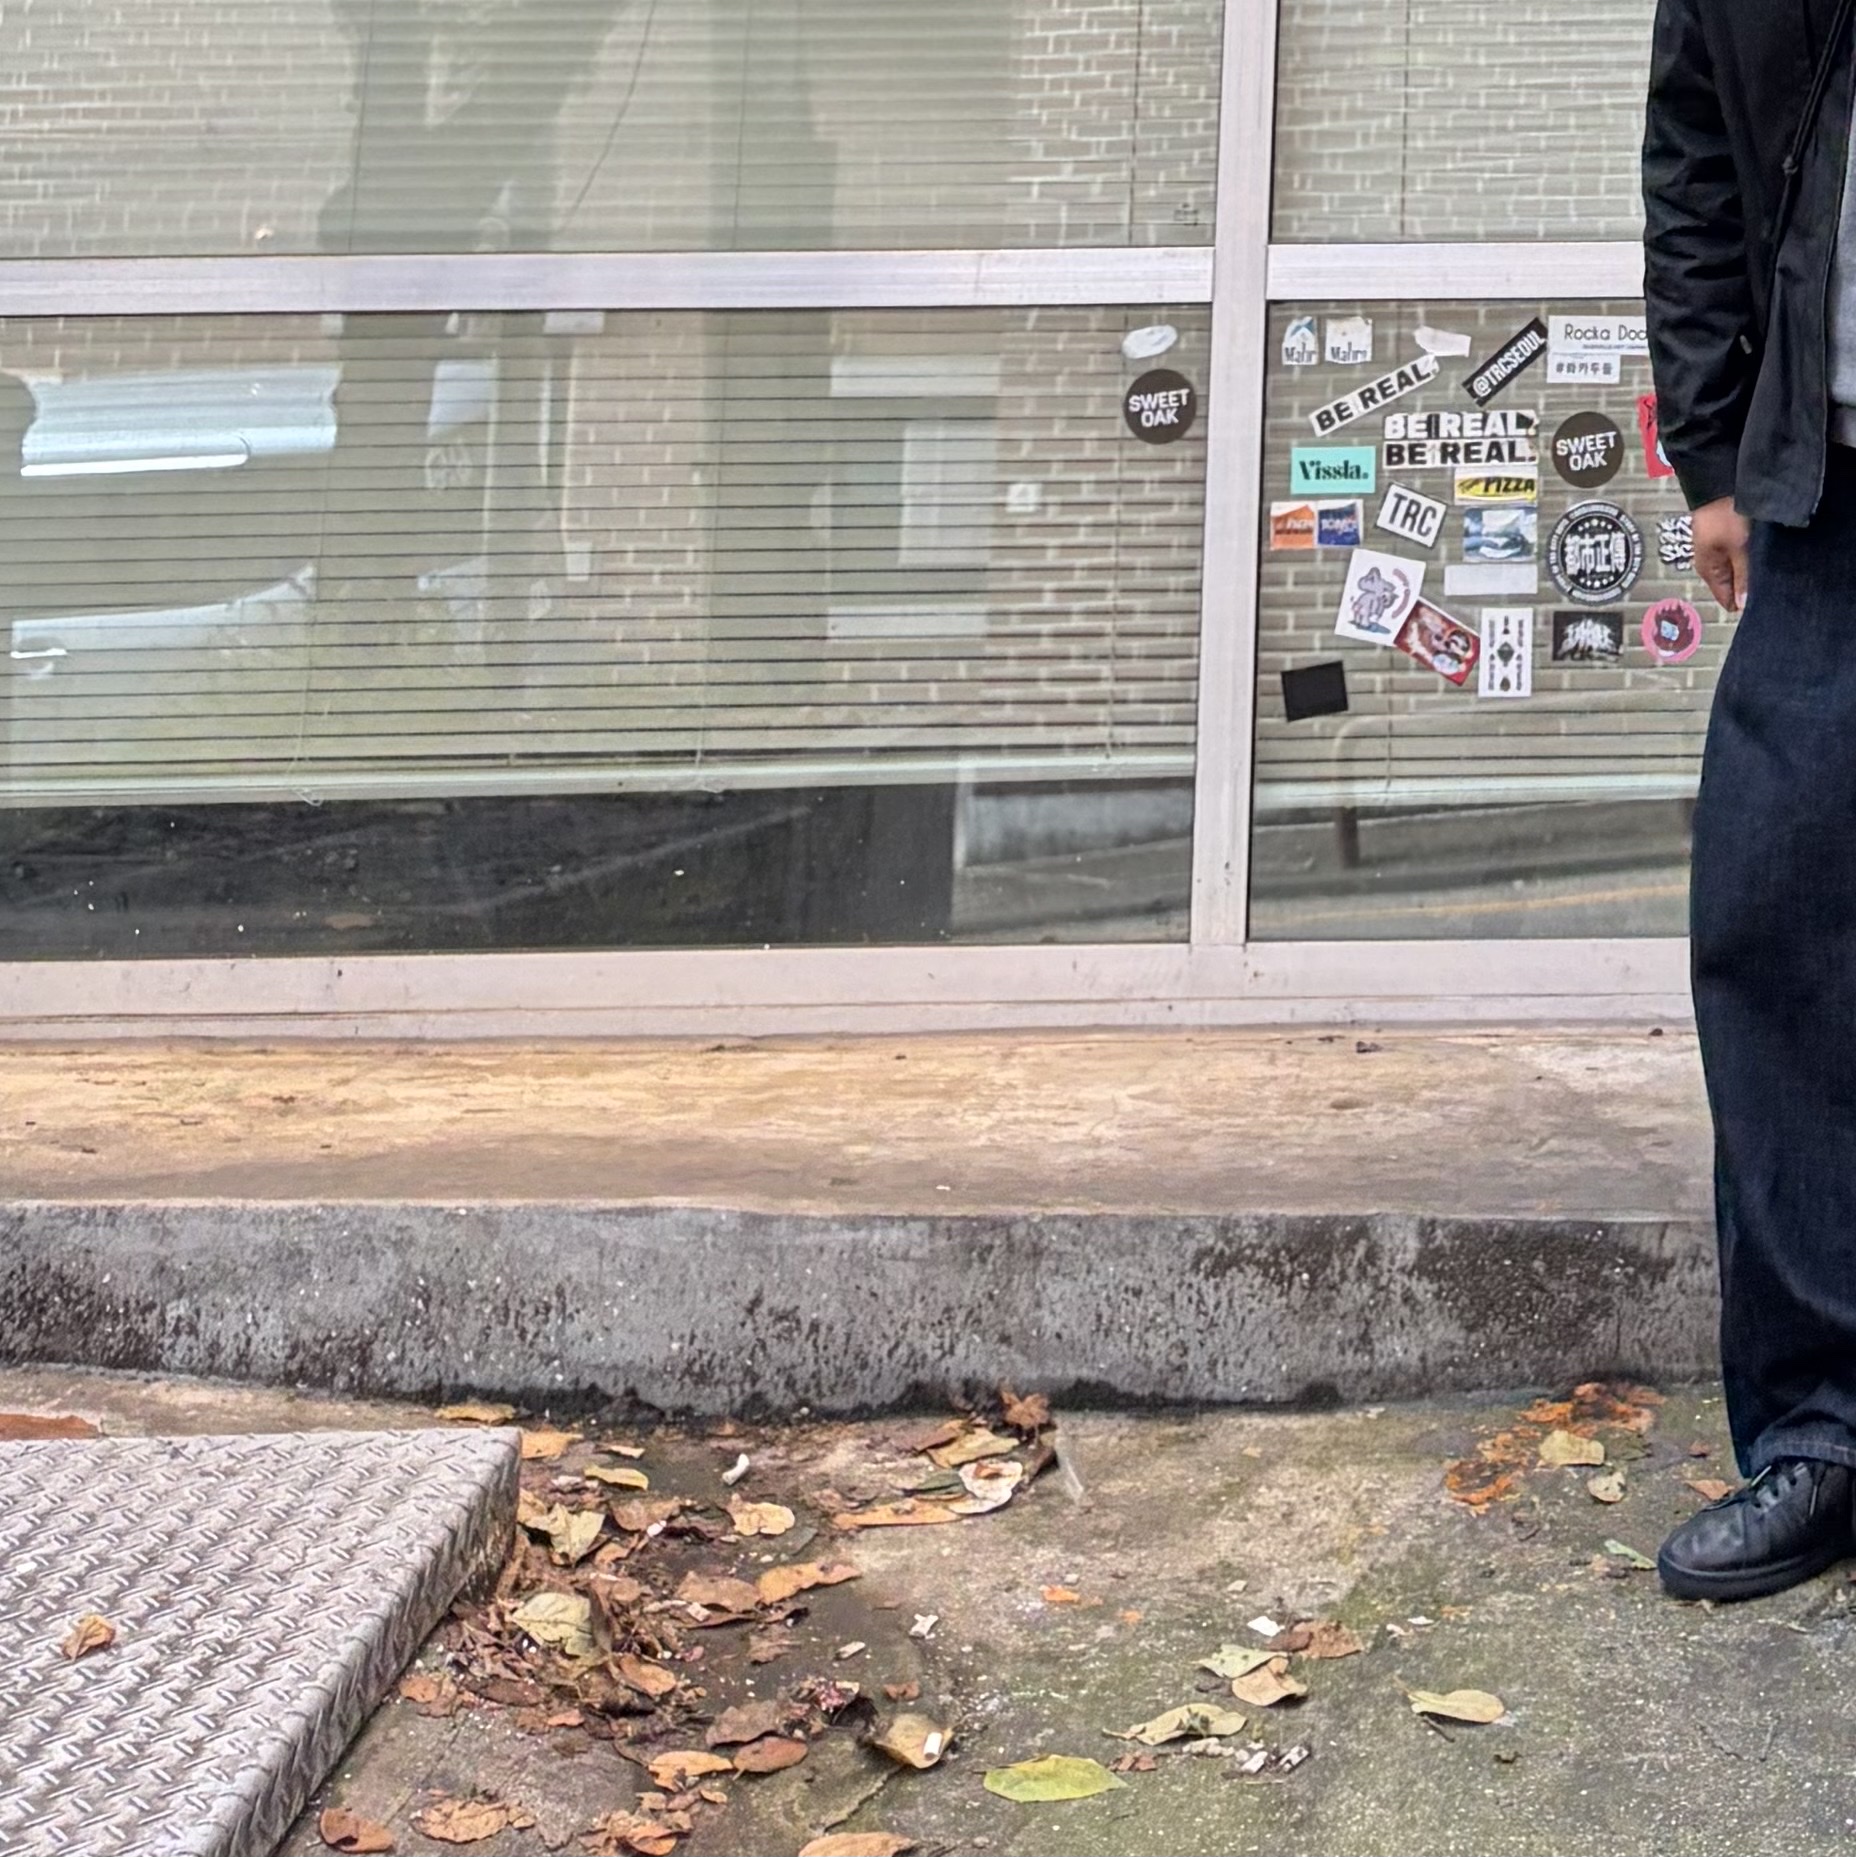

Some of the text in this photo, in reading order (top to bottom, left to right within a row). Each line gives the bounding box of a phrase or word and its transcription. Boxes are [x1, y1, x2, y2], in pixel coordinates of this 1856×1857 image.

[1564, 323, 1611, 341] Rocka
[1472, 330, 1546, 397] @TRCSEOUL
[1128, 388, 1190, 413] SWEET
[1141, 407, 1179, 428] OAK
[1316, 401, 1354, 432] BE
[1384, 413, 1428, 439] BE
[1386, 443, 1427, 466] BE
[1556, 431, 1617, 456] SWEET
[1569, 450, 1608, 471] OAK
[1483, 476, 1535, 493] PIZZA
[1389, 492, 1437, 537] TRC
